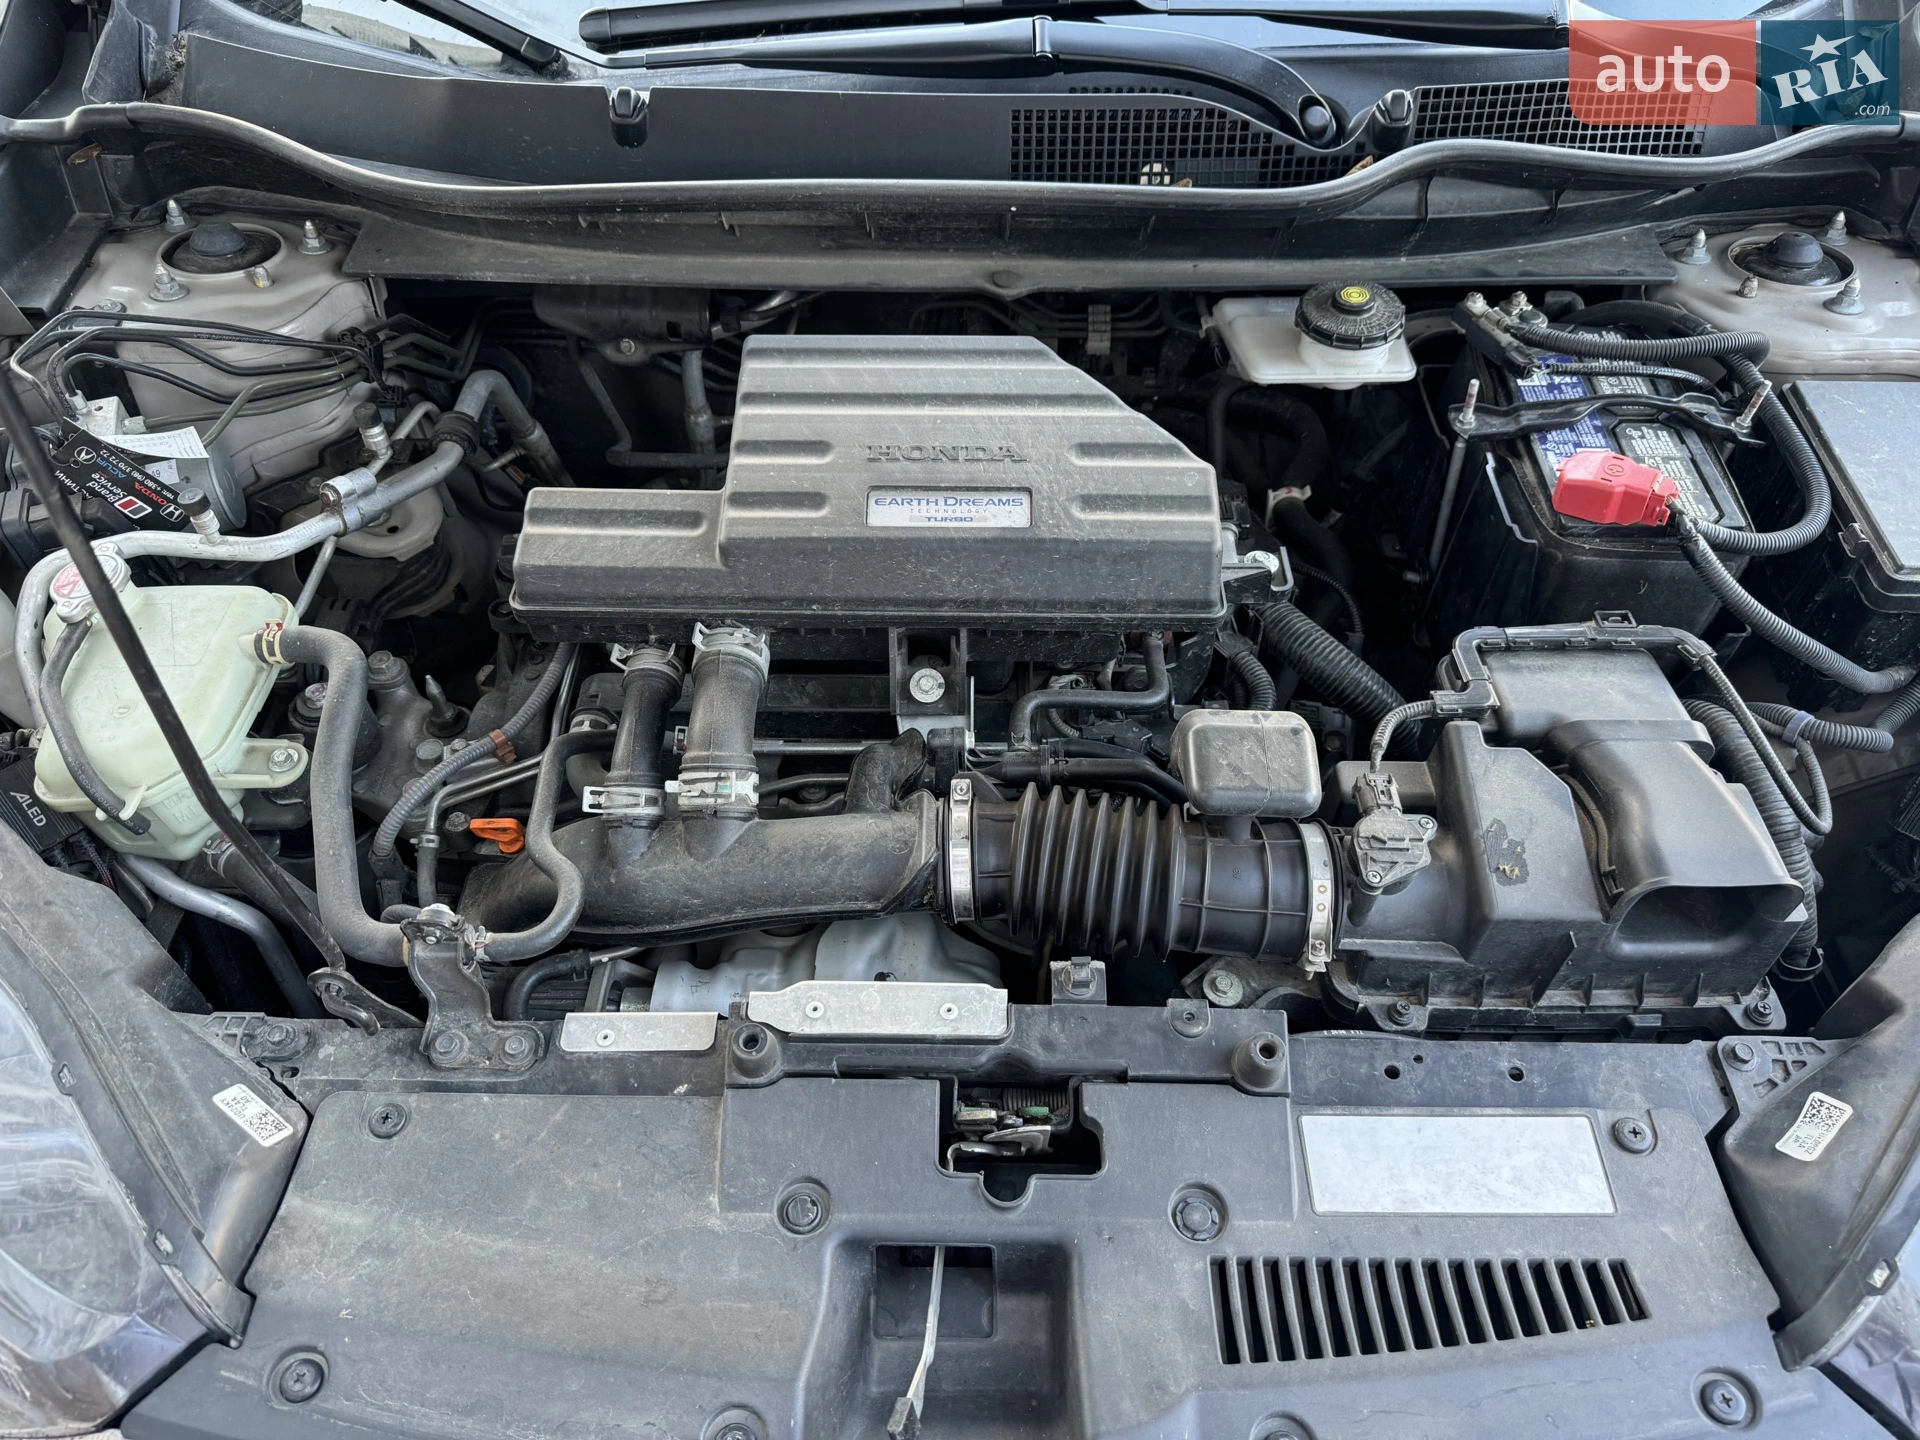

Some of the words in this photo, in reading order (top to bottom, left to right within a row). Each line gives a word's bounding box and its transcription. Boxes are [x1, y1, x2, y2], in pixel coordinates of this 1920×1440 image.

[866, 444, 1028, 462] HONDA
[118, 462, 133, 473] 370
[86, 480, 119, 503] Brand
[91, 472, 128, 499] Service
[144, 478, 161, 491] +380
[874, 497, 940, 507] EARTH
[944, 496, 1023, 507] DREAMS
[9, 791, 47, 827] ALED
